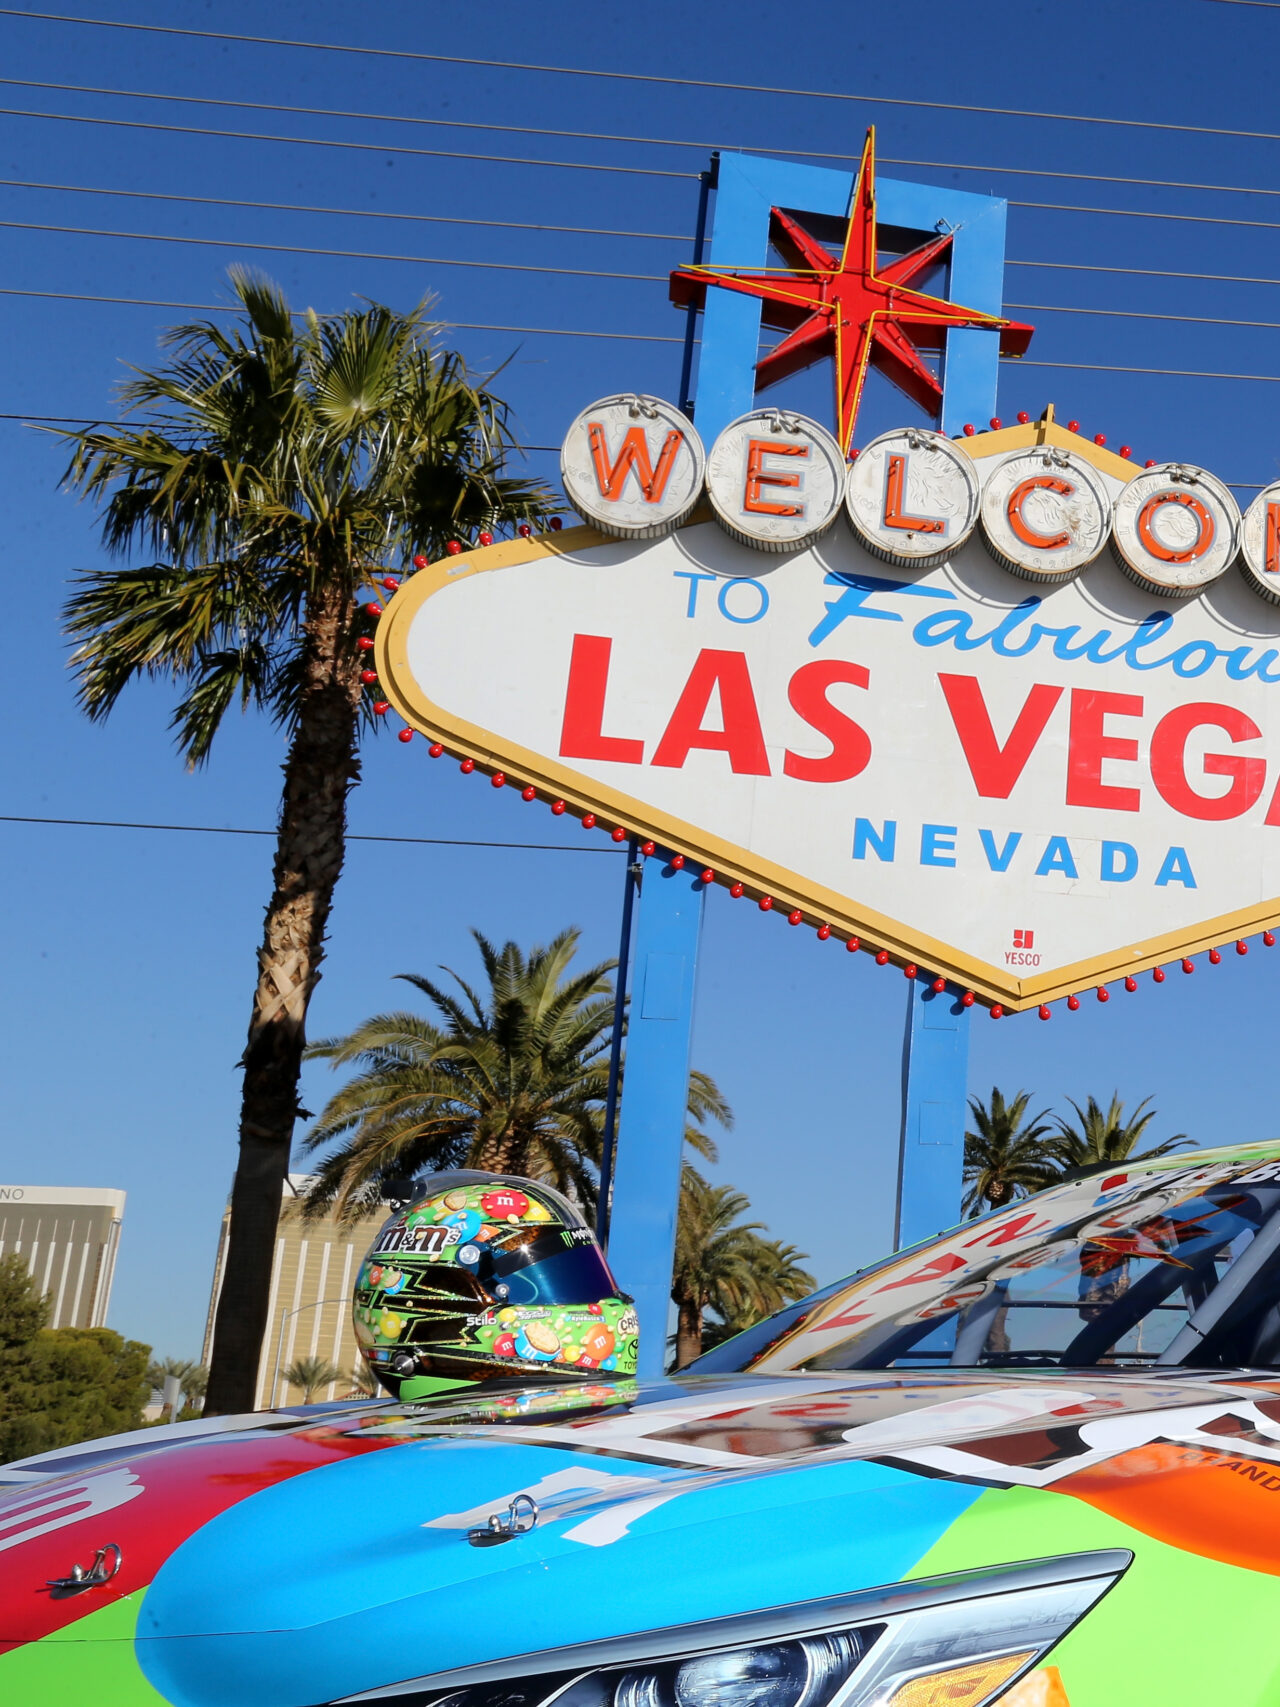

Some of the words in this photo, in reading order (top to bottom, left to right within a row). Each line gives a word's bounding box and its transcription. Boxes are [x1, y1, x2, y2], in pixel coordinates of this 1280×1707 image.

[673, 571, 769, 624] TO
[559, 633, 872, 783] LAS
[852, 817, 1198, 889] NEVADA
[1005, 952, 1041, 966] YESCO
[466, 1314, 498, 1327] Stilo
